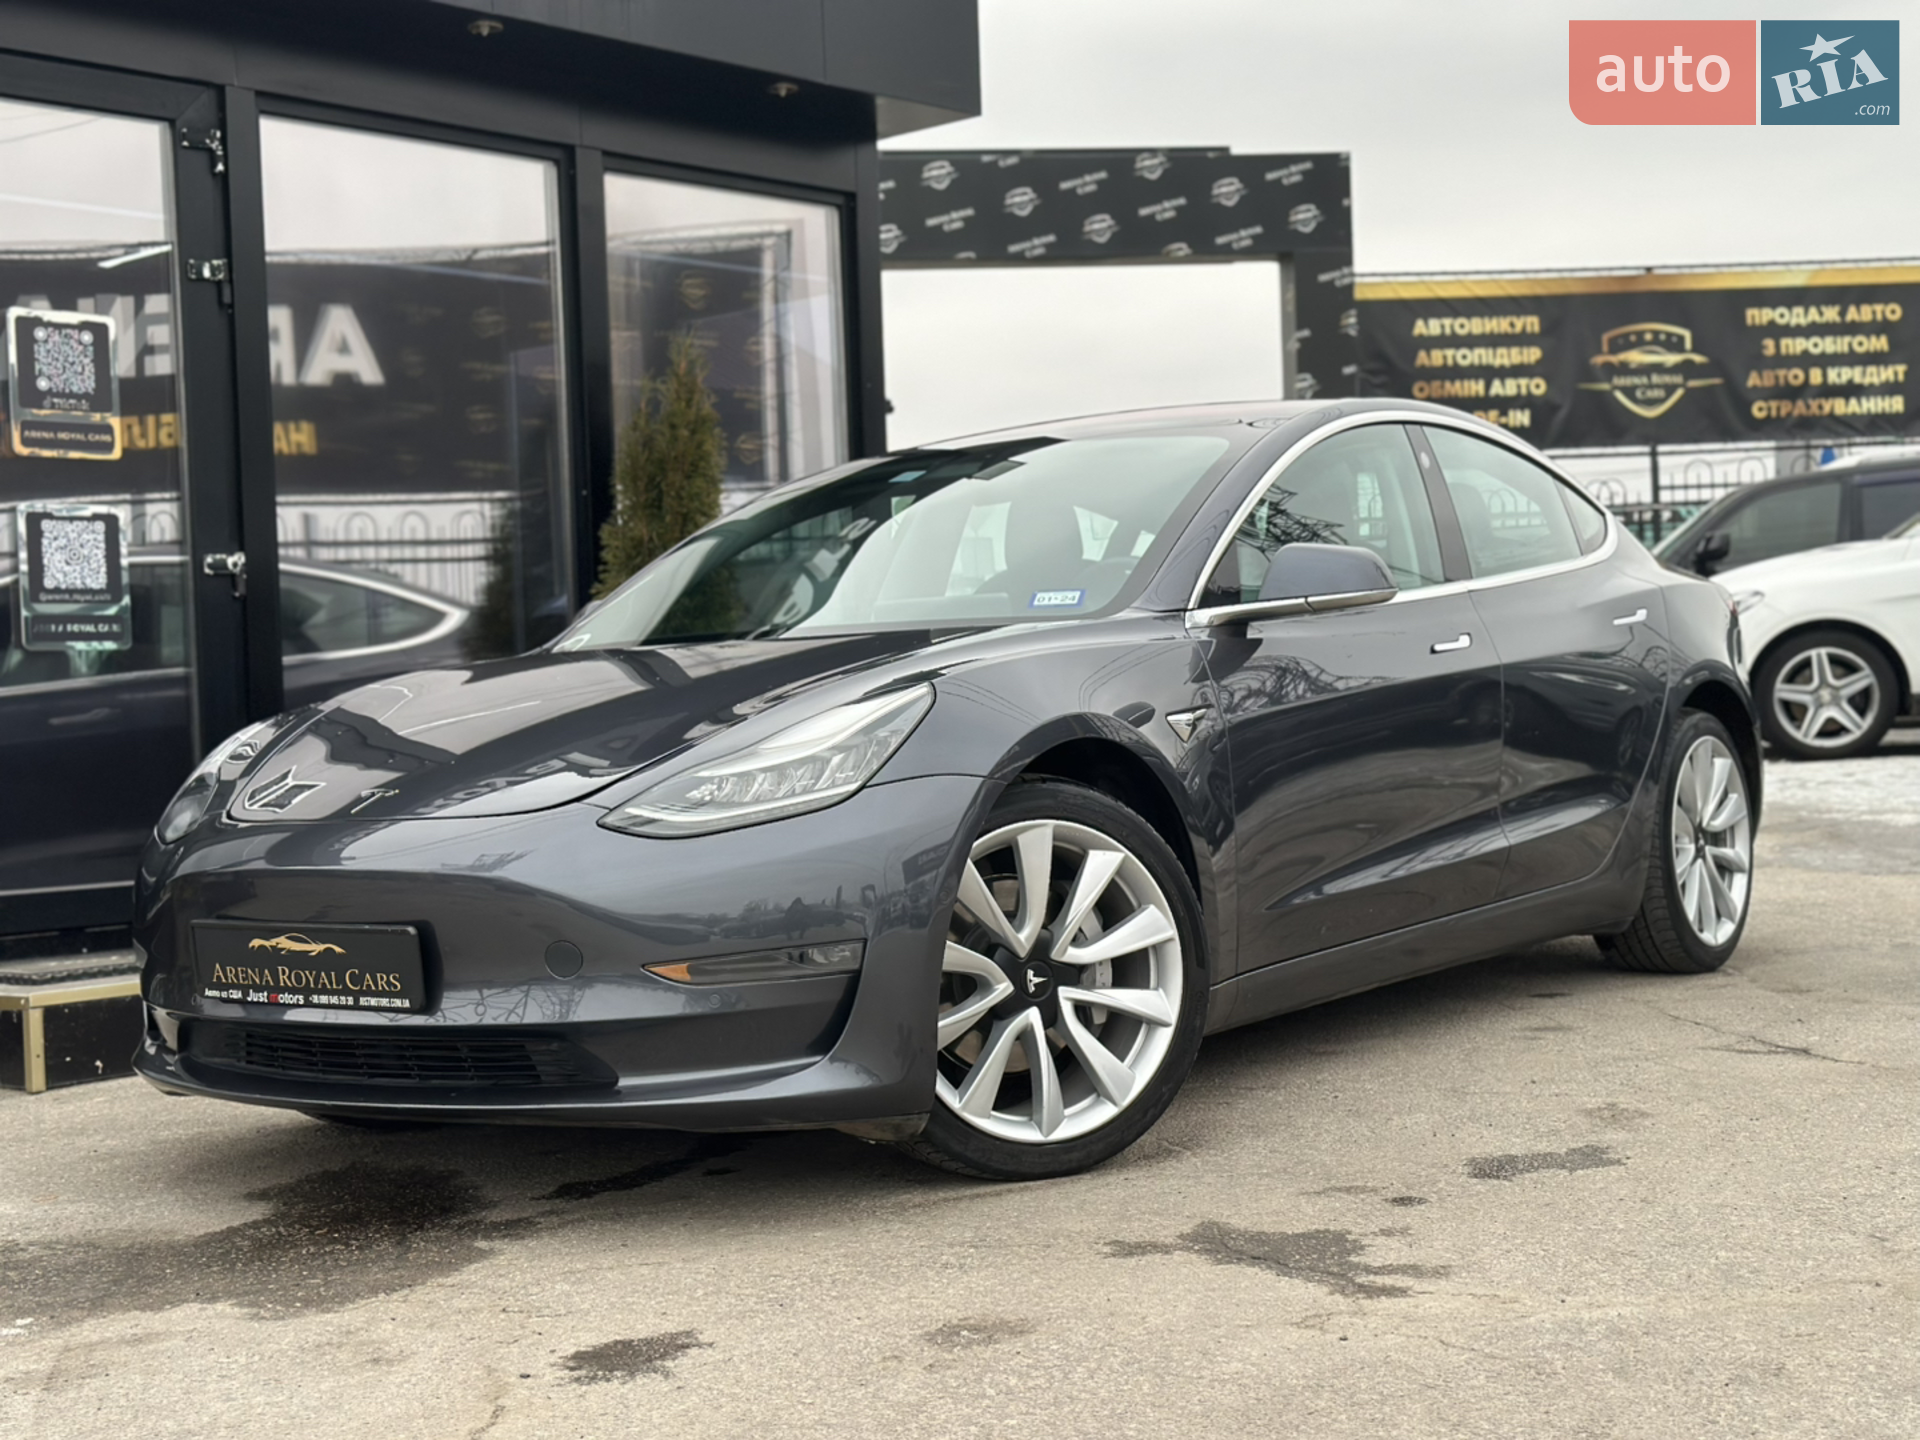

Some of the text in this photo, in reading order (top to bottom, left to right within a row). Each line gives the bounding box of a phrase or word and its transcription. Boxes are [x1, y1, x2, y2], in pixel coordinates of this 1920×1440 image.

[1412, 315, 1541, 336] АВТОВИКУП
[1745, 302, 1903, 327] ПРОДАЖ АВТО
[1779, 333, 1890, 355] ПРОБІГОМ
[1414, 346, 1543, 368] АВТОПІДБІР
[1746, 363, 1908, 388] АВТО В КРЕДИТ
[1412, 376, 1547, 399] ОБМІН АВТО
[1751, 394, 1905, 420] СТРАХУВАННЯ
[212, 962, 401, 992] ARENA ROYAL CARS
[246, 988, 269, 1003] Just
